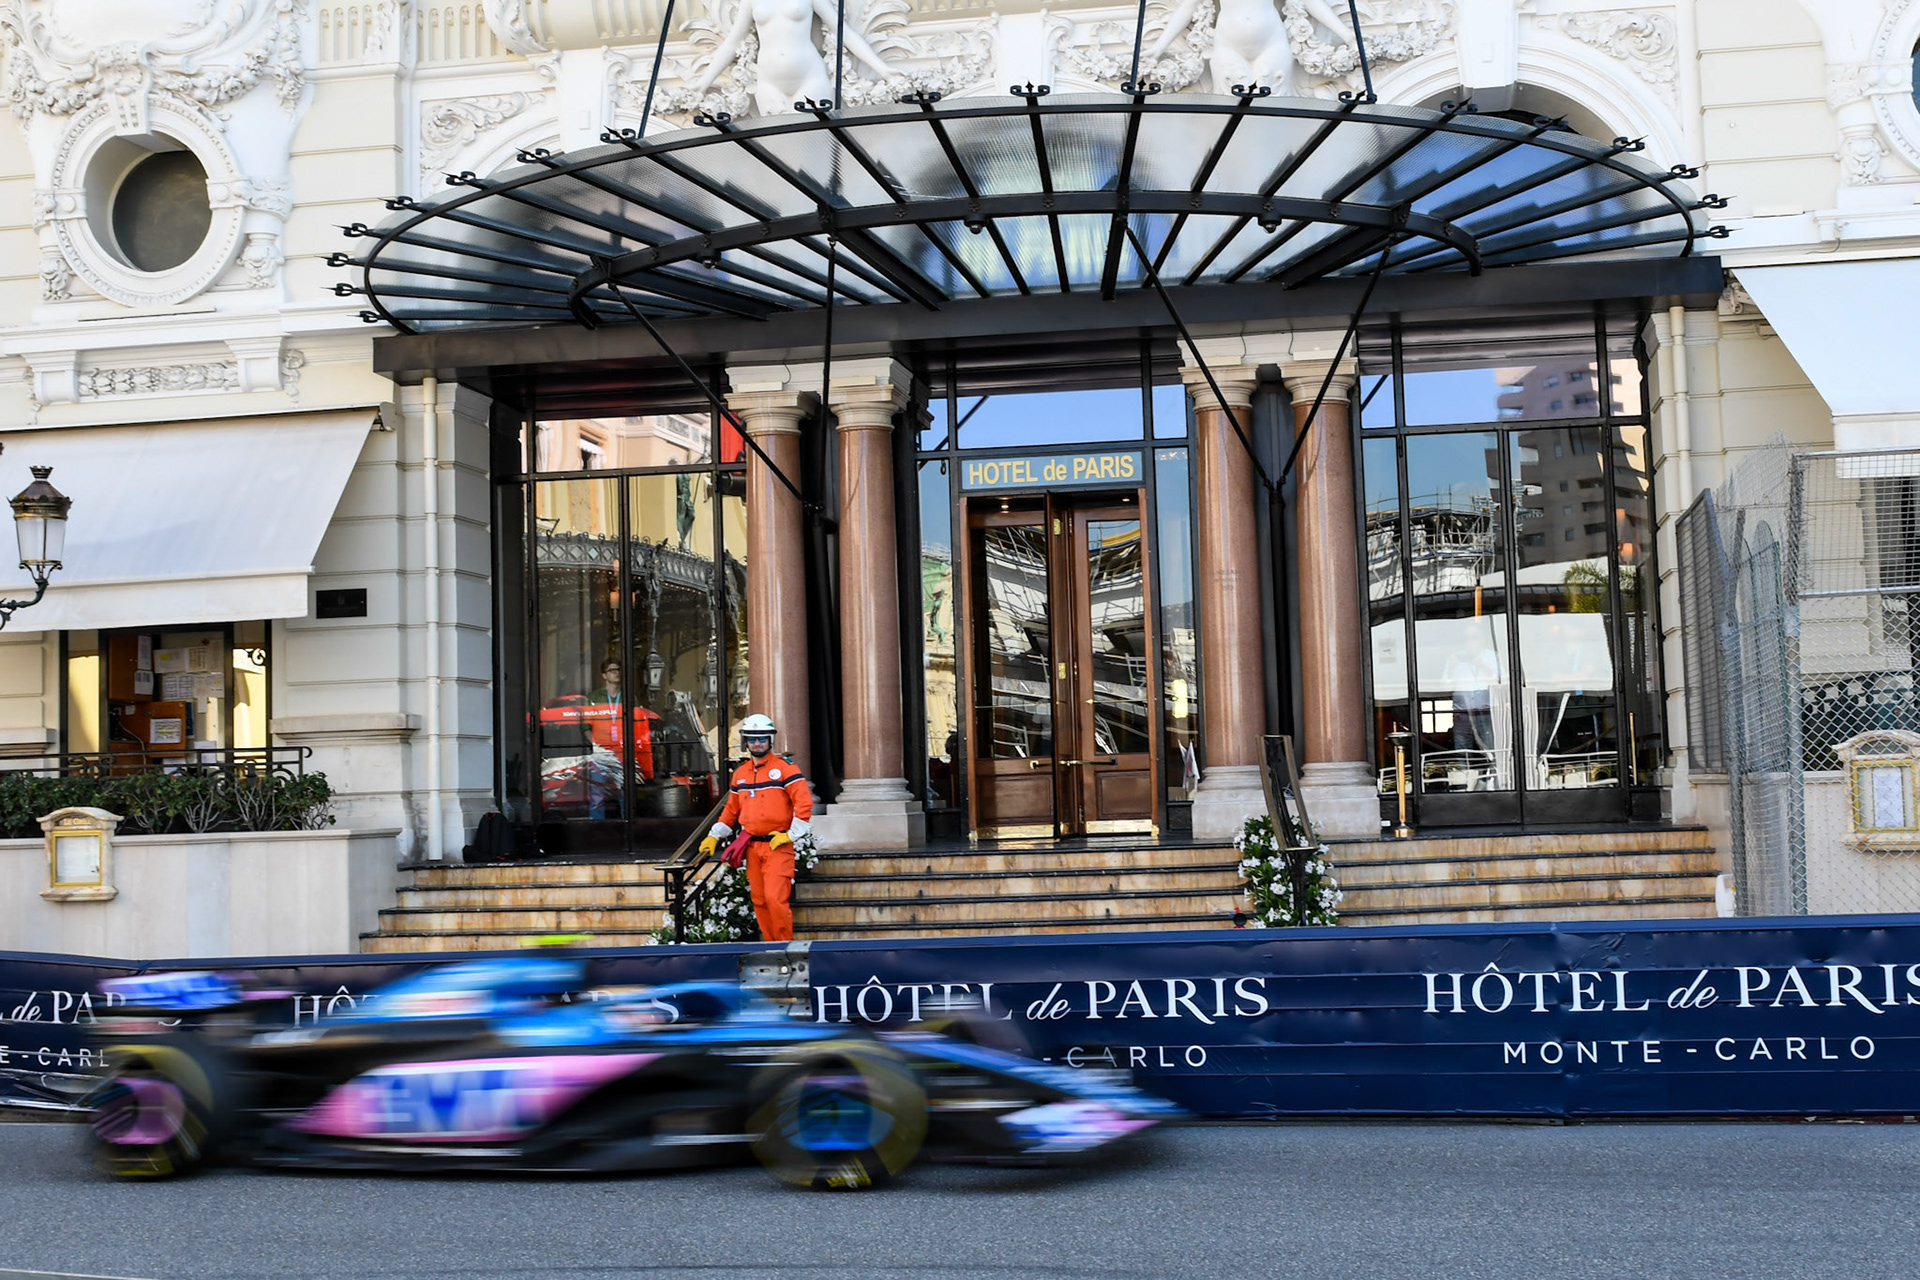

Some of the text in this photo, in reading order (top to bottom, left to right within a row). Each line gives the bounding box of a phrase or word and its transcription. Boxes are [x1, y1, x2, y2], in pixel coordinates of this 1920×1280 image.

[969, 454, 1134, 485] HOTEL de PARIS
[1026, 983, 1072, 1021] de
[1083, 977, 1269, 1026] PARIS
[1422, 962, 1651, 1014] HÔTEL
[1667, 969, 1720, 1010] de
[10, 991, 42, 1022] de
[37, 1047, 110, 1067] CARL
[1066, 1045, 1208, 1068] CARLO
